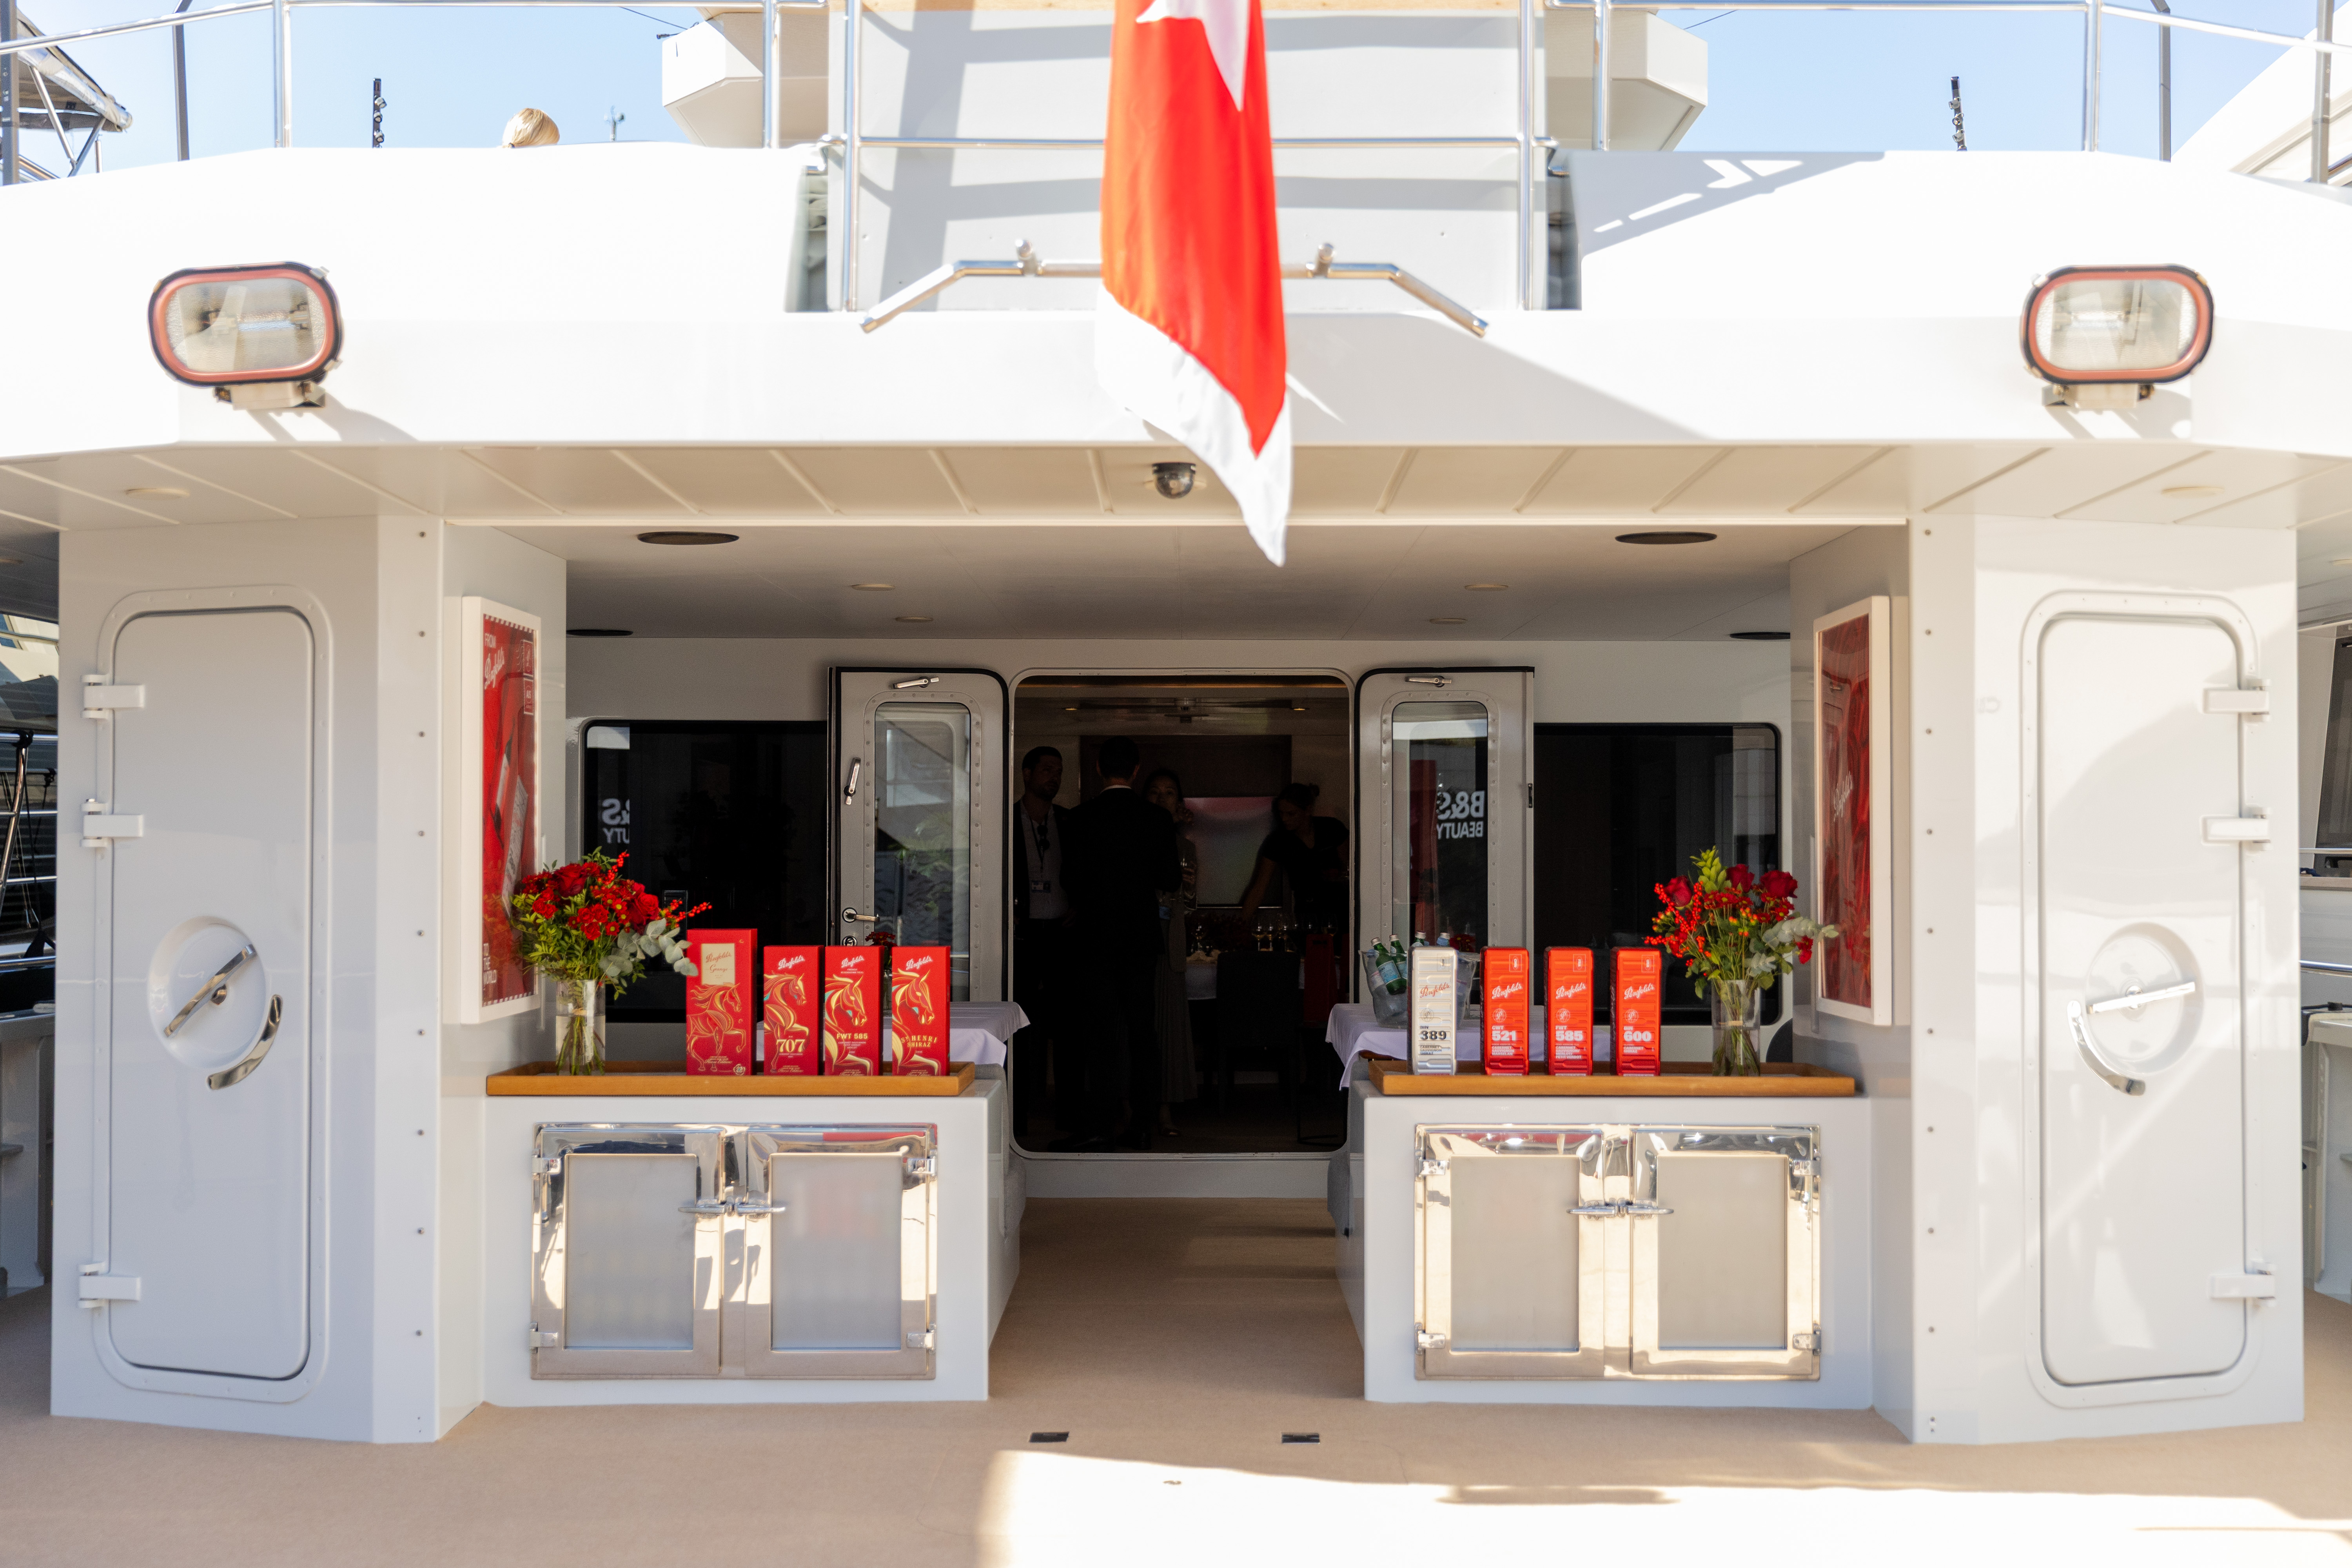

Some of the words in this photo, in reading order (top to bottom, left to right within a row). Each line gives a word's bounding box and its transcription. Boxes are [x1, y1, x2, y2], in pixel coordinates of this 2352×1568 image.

[485, 633, 496, 648] FROM
[484, 646, 505, 690] Penfolds
[483, 943, 489, 956] TO
[710, 964, 728, 973] Grange
[778, 955, 805, 969] Penfolds
[841, 955, 864, 968] Penfolds
[906, 955, 933, 970] Penfolds
[483, 969, 497, 985] WORLD
[1420, 982, 1449, 998] Penfolds
[1492, 982, 1522, 999] Penfolds
[1555, 982, 1586, 999] Penfolds
[1624, 983, 1654, 1000] Penfolds
[1420, 1031, 1446, 1040] 389
[1492, 1031, 1516, 1041] 521
[1555, 1031, 1583, 1041] 585
[1624, 1031, 1651, 1042] 600
[776, 1039, 805, 1052] 707
